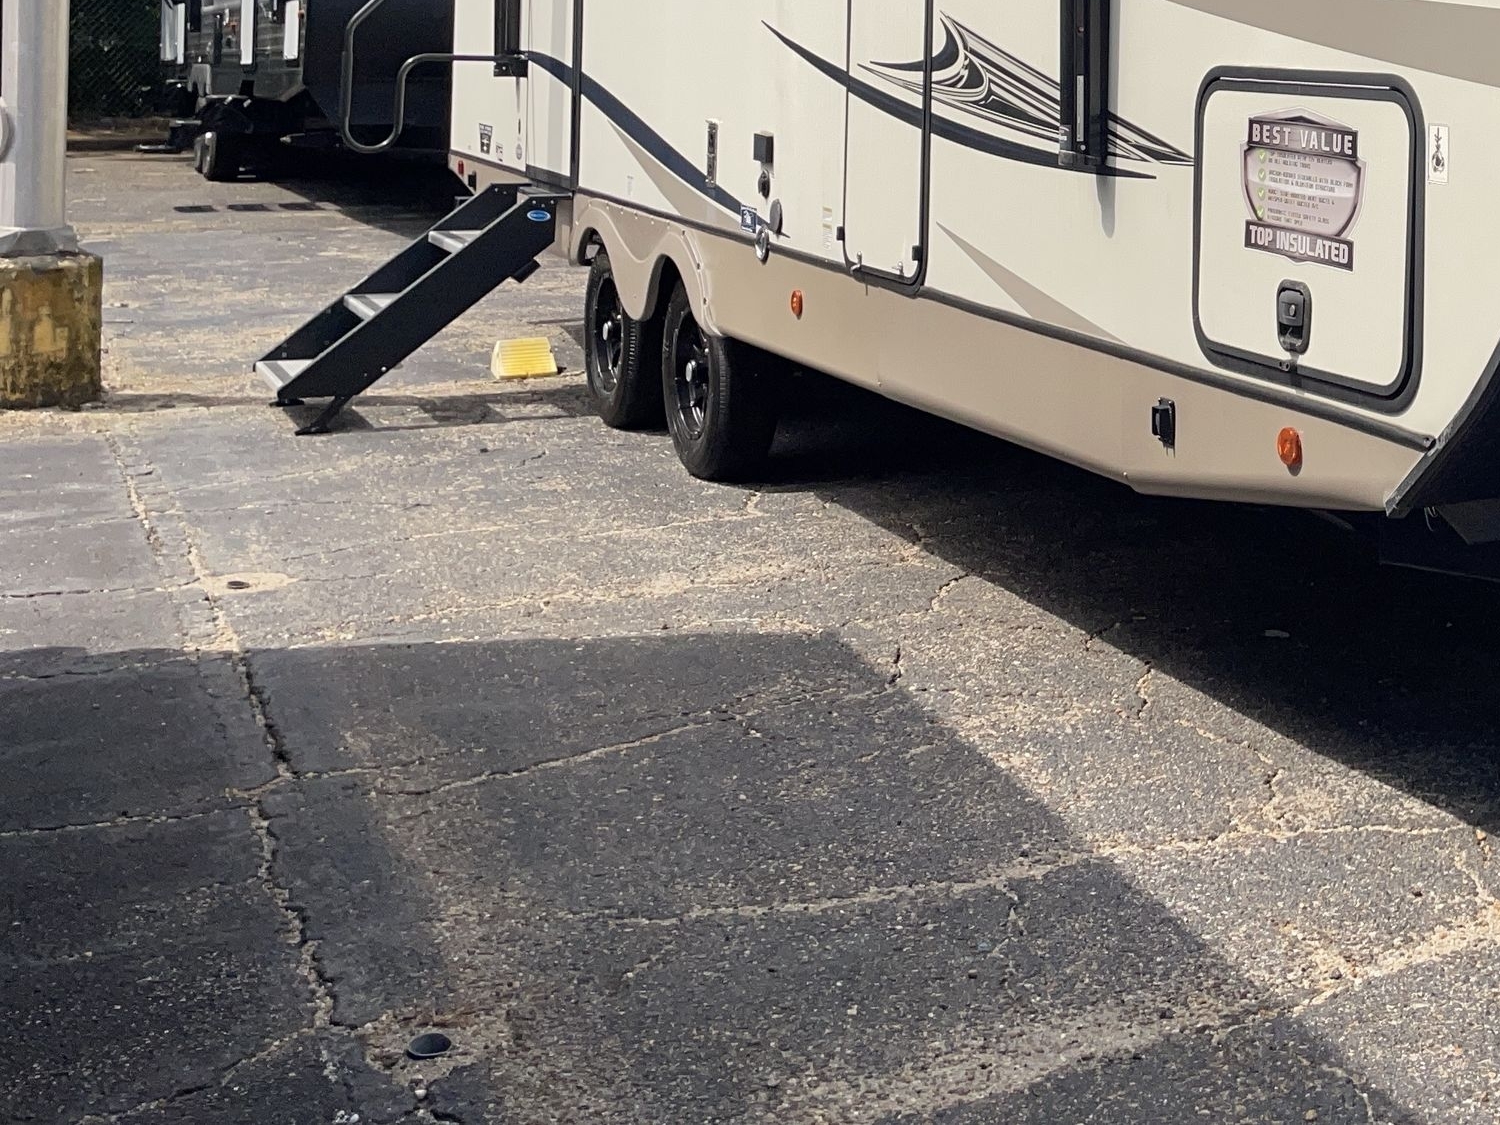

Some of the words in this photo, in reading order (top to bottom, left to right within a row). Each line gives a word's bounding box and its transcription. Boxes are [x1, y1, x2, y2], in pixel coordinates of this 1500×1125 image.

[1252, 123, 1291, 146] BEST
[1300, 129, 1353, 155] VALUE
[1249, 225, 1273, 247] TOP
[1276, 230, 1349, 264] INSULATED
